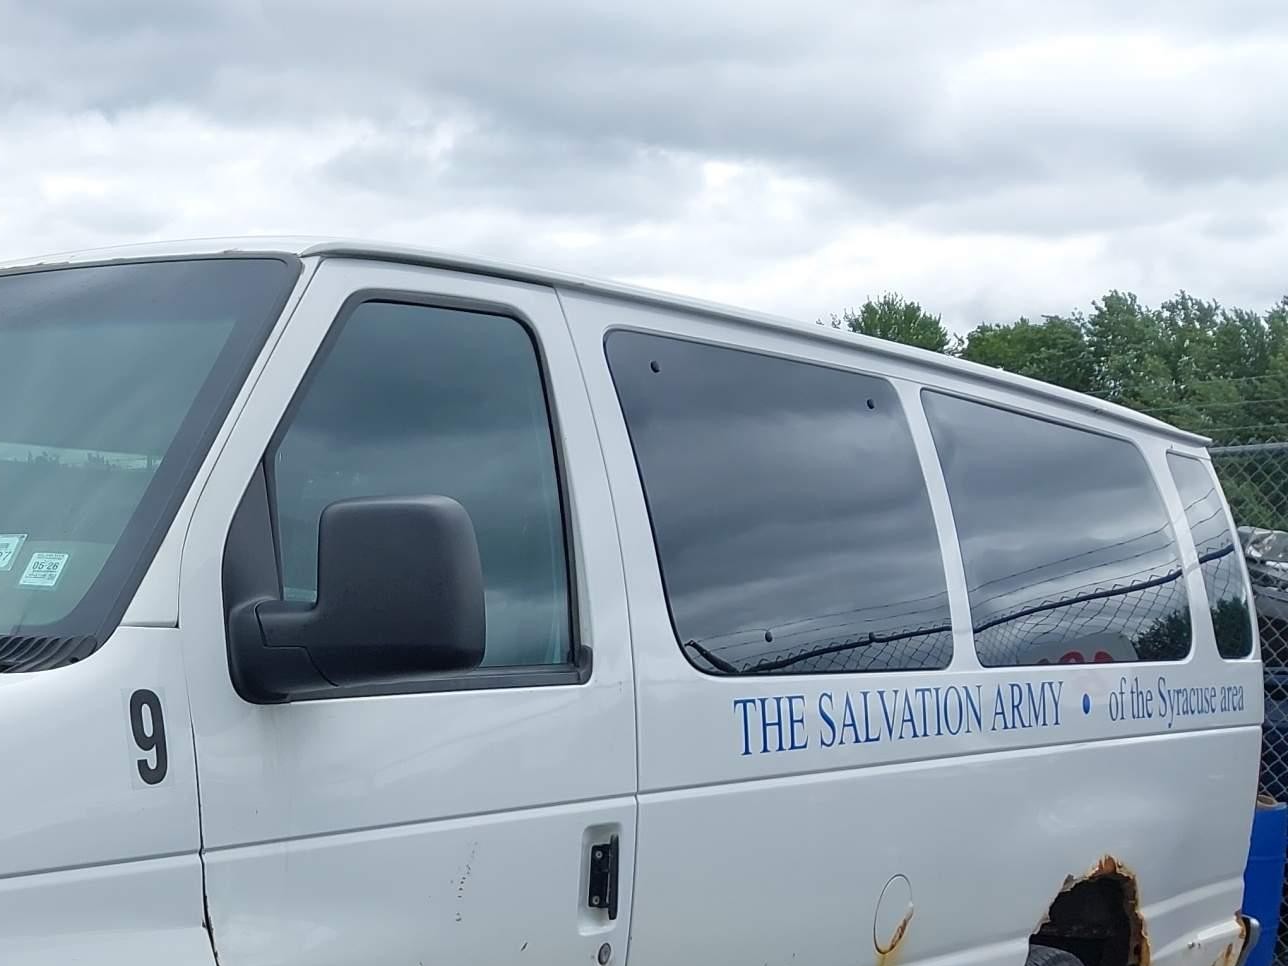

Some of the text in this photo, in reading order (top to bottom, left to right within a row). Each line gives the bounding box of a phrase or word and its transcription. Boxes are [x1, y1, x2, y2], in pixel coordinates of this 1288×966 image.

[129, 688, 168, 785] 9
[733, 681, 1064, 756] THE SALVATION ARMY
[1109, 676, 1244, 728] of the Syracuse area
